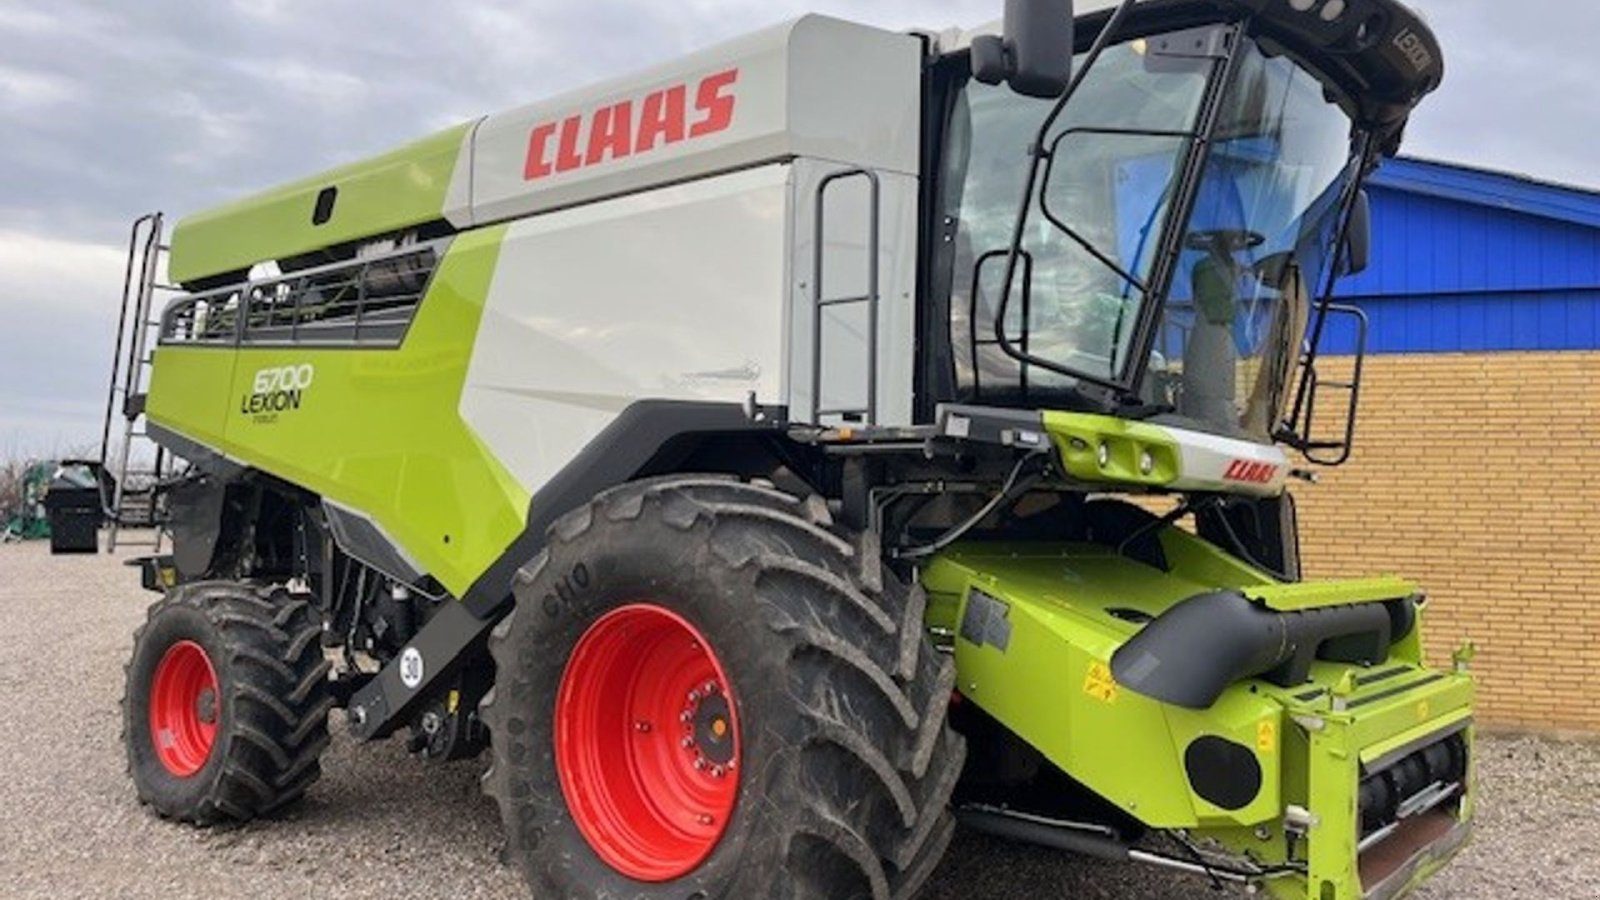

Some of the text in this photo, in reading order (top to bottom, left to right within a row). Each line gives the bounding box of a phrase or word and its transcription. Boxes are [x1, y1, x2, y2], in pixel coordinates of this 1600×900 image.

[523, 68, 738, 180] CLAAS
[253, 362, 313, 393] 6700
[240, 388, 301, 414] LEXION
[1223, 459, 1278, 483] CLAAS
[405, 656, 418, 679] 30
